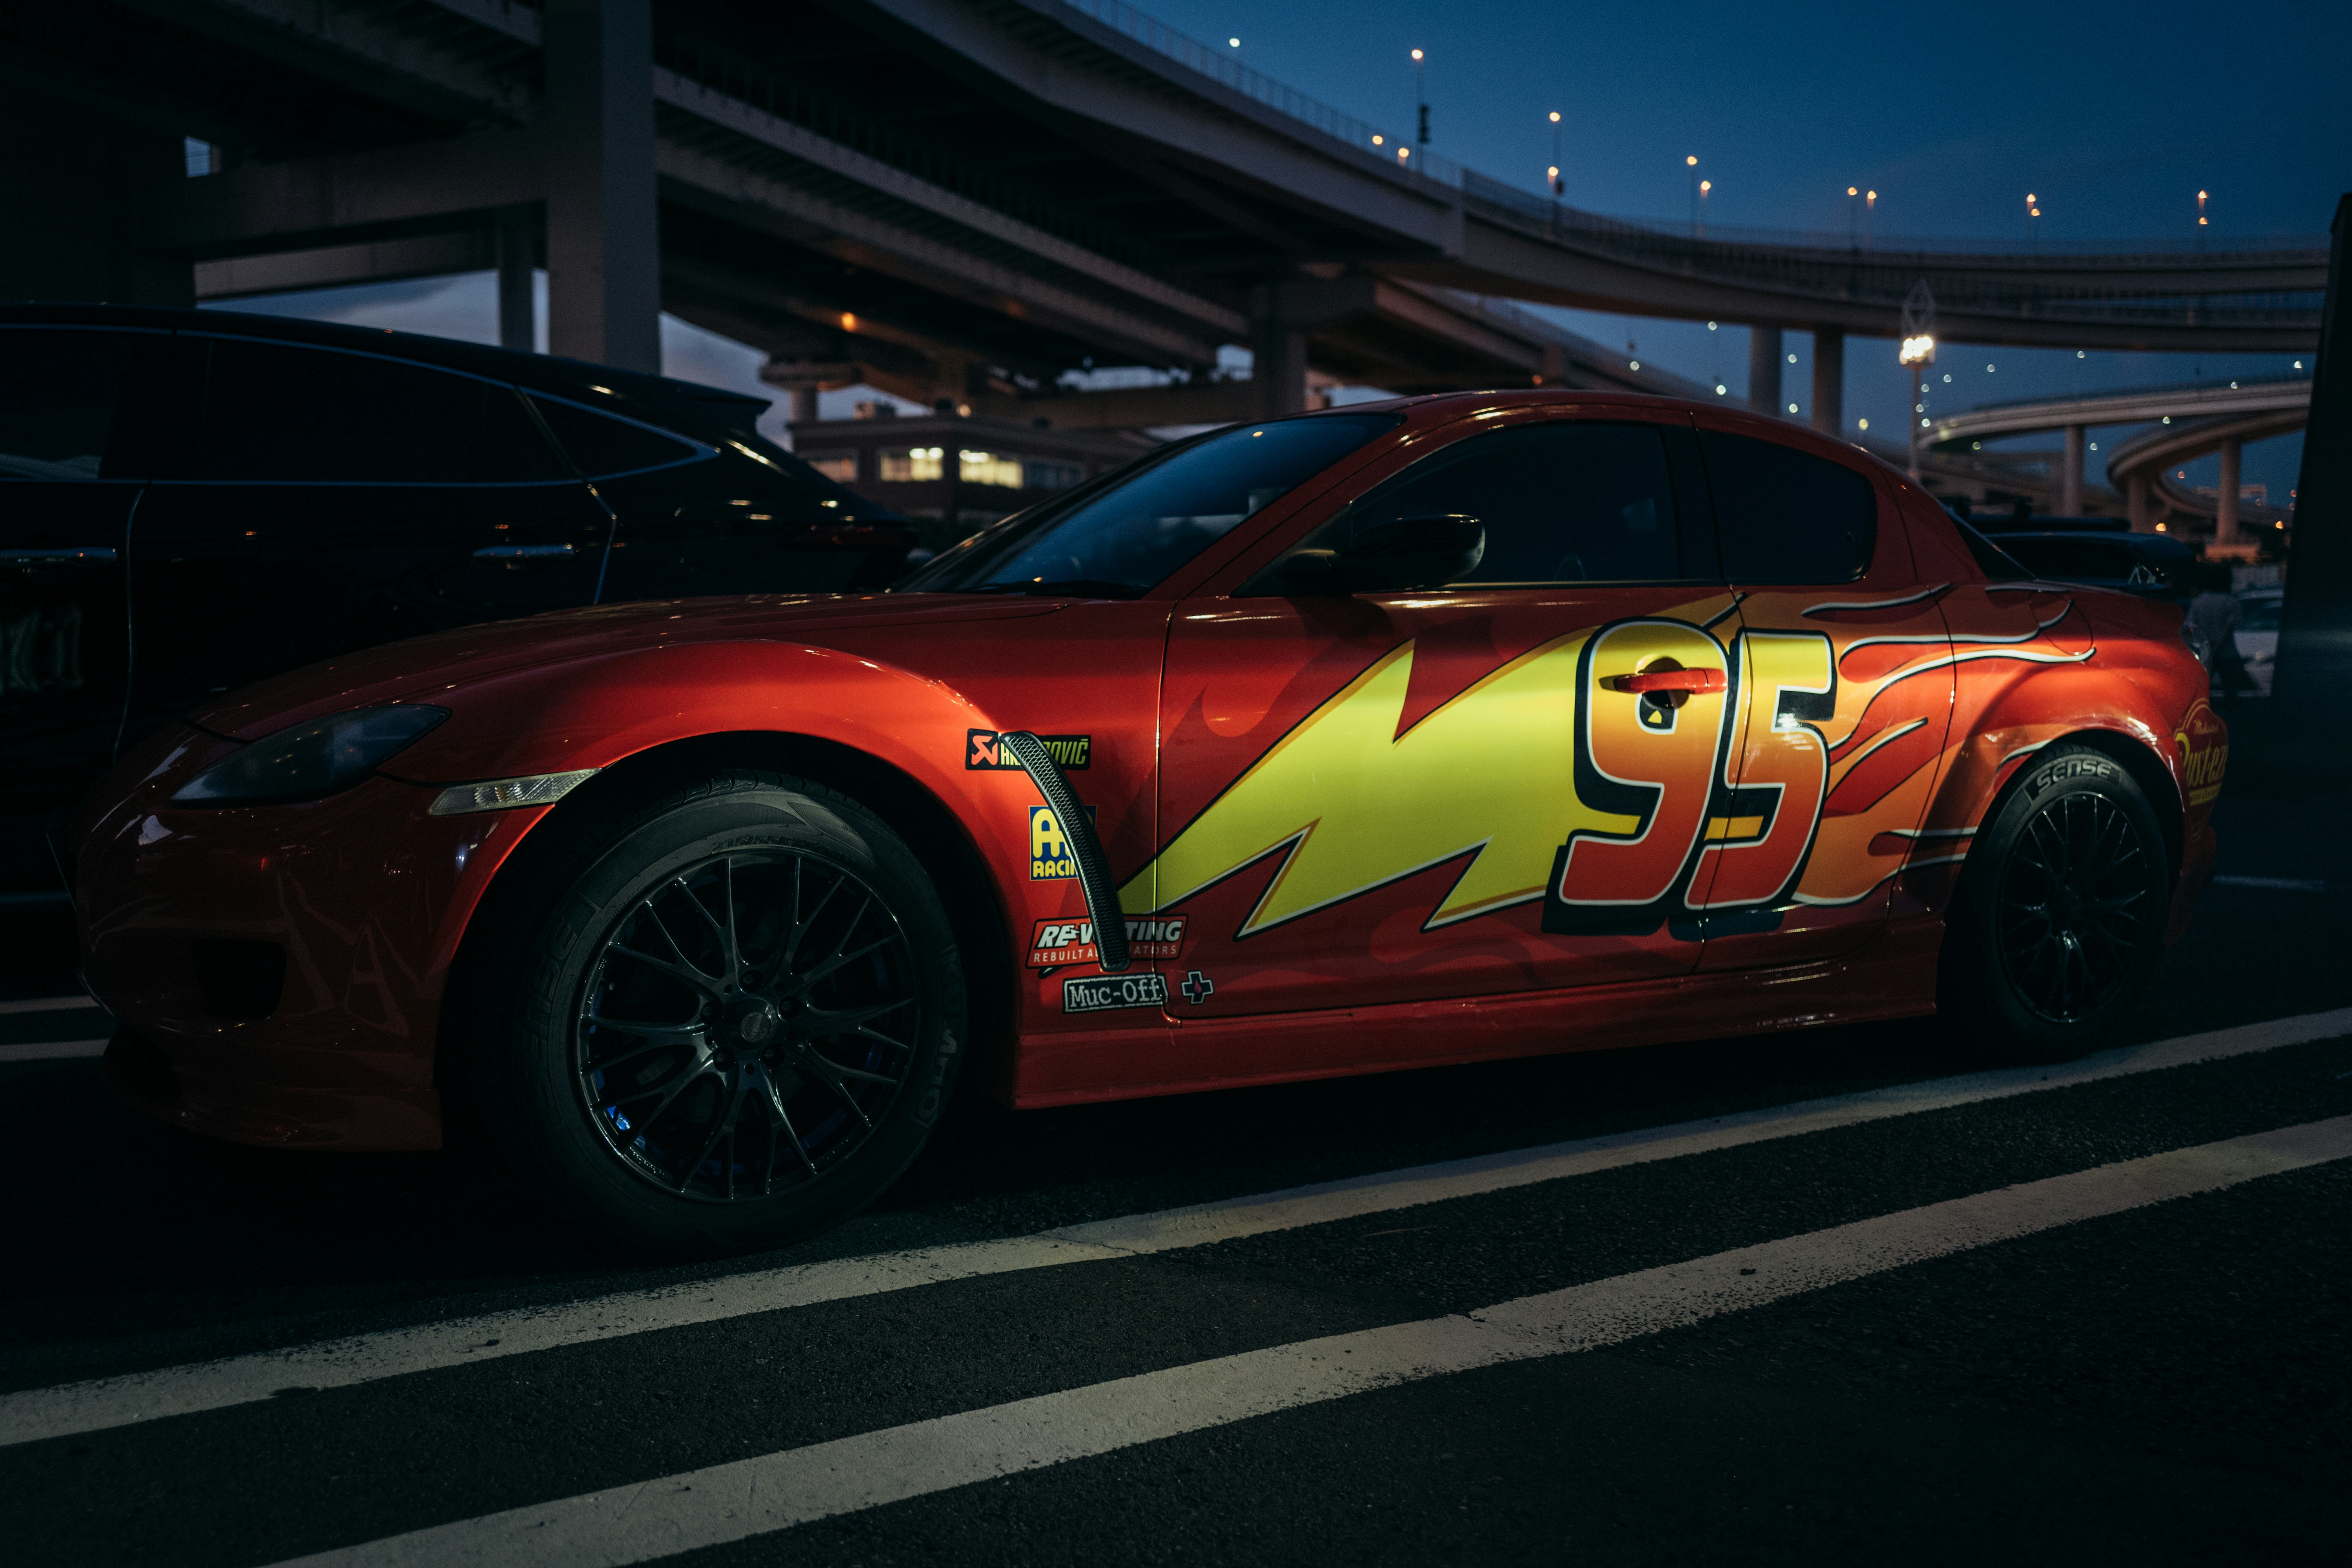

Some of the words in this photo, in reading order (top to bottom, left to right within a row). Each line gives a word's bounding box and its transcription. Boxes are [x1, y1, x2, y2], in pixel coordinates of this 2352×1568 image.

[1001, 738, 1089, 766] AOVIČ
[1555, 619, 1835, 914] 95
[2036, 760, 2112, 793] SENSE
[1033, 859, 1075, 878] RACI
[1037, 920, 1183, 948] RE-VTING
[1034, 949, 1084, 963] REBUILT
[1086, 945, 1177, 958] AATORS
[1069, 978, 1162, 1007] Muc-Off
[520, 915, 577, 1107] SENSE
[918, 951, 962, 1120] KUMHO
